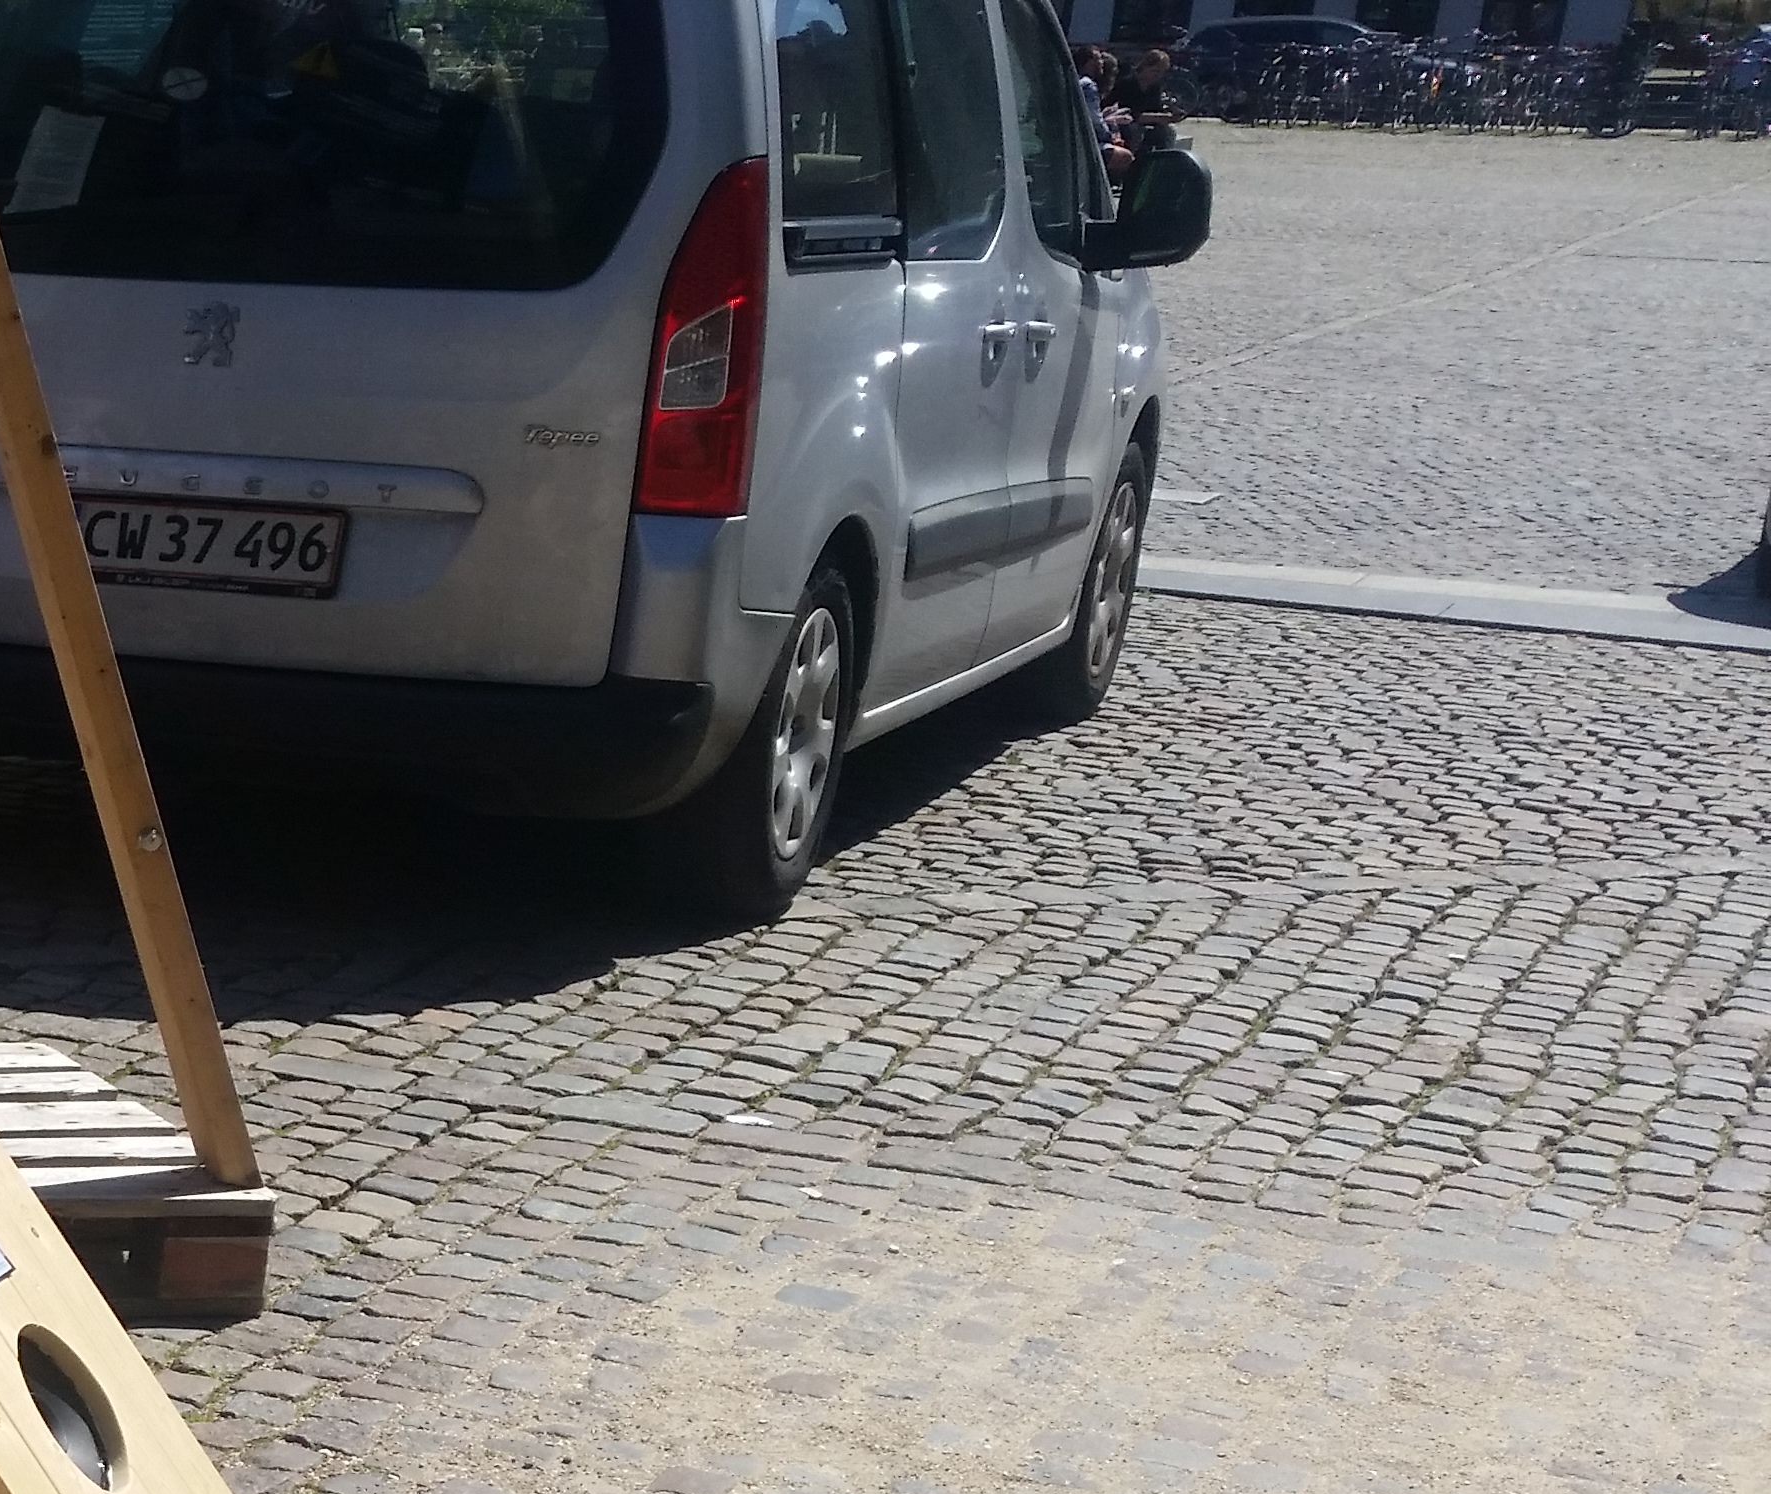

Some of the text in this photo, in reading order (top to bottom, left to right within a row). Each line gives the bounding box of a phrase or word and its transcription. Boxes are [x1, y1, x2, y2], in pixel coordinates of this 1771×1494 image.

[63, 465, 397, 503] EUGEOT
[84, 510, 328, 573] CW 37 496
